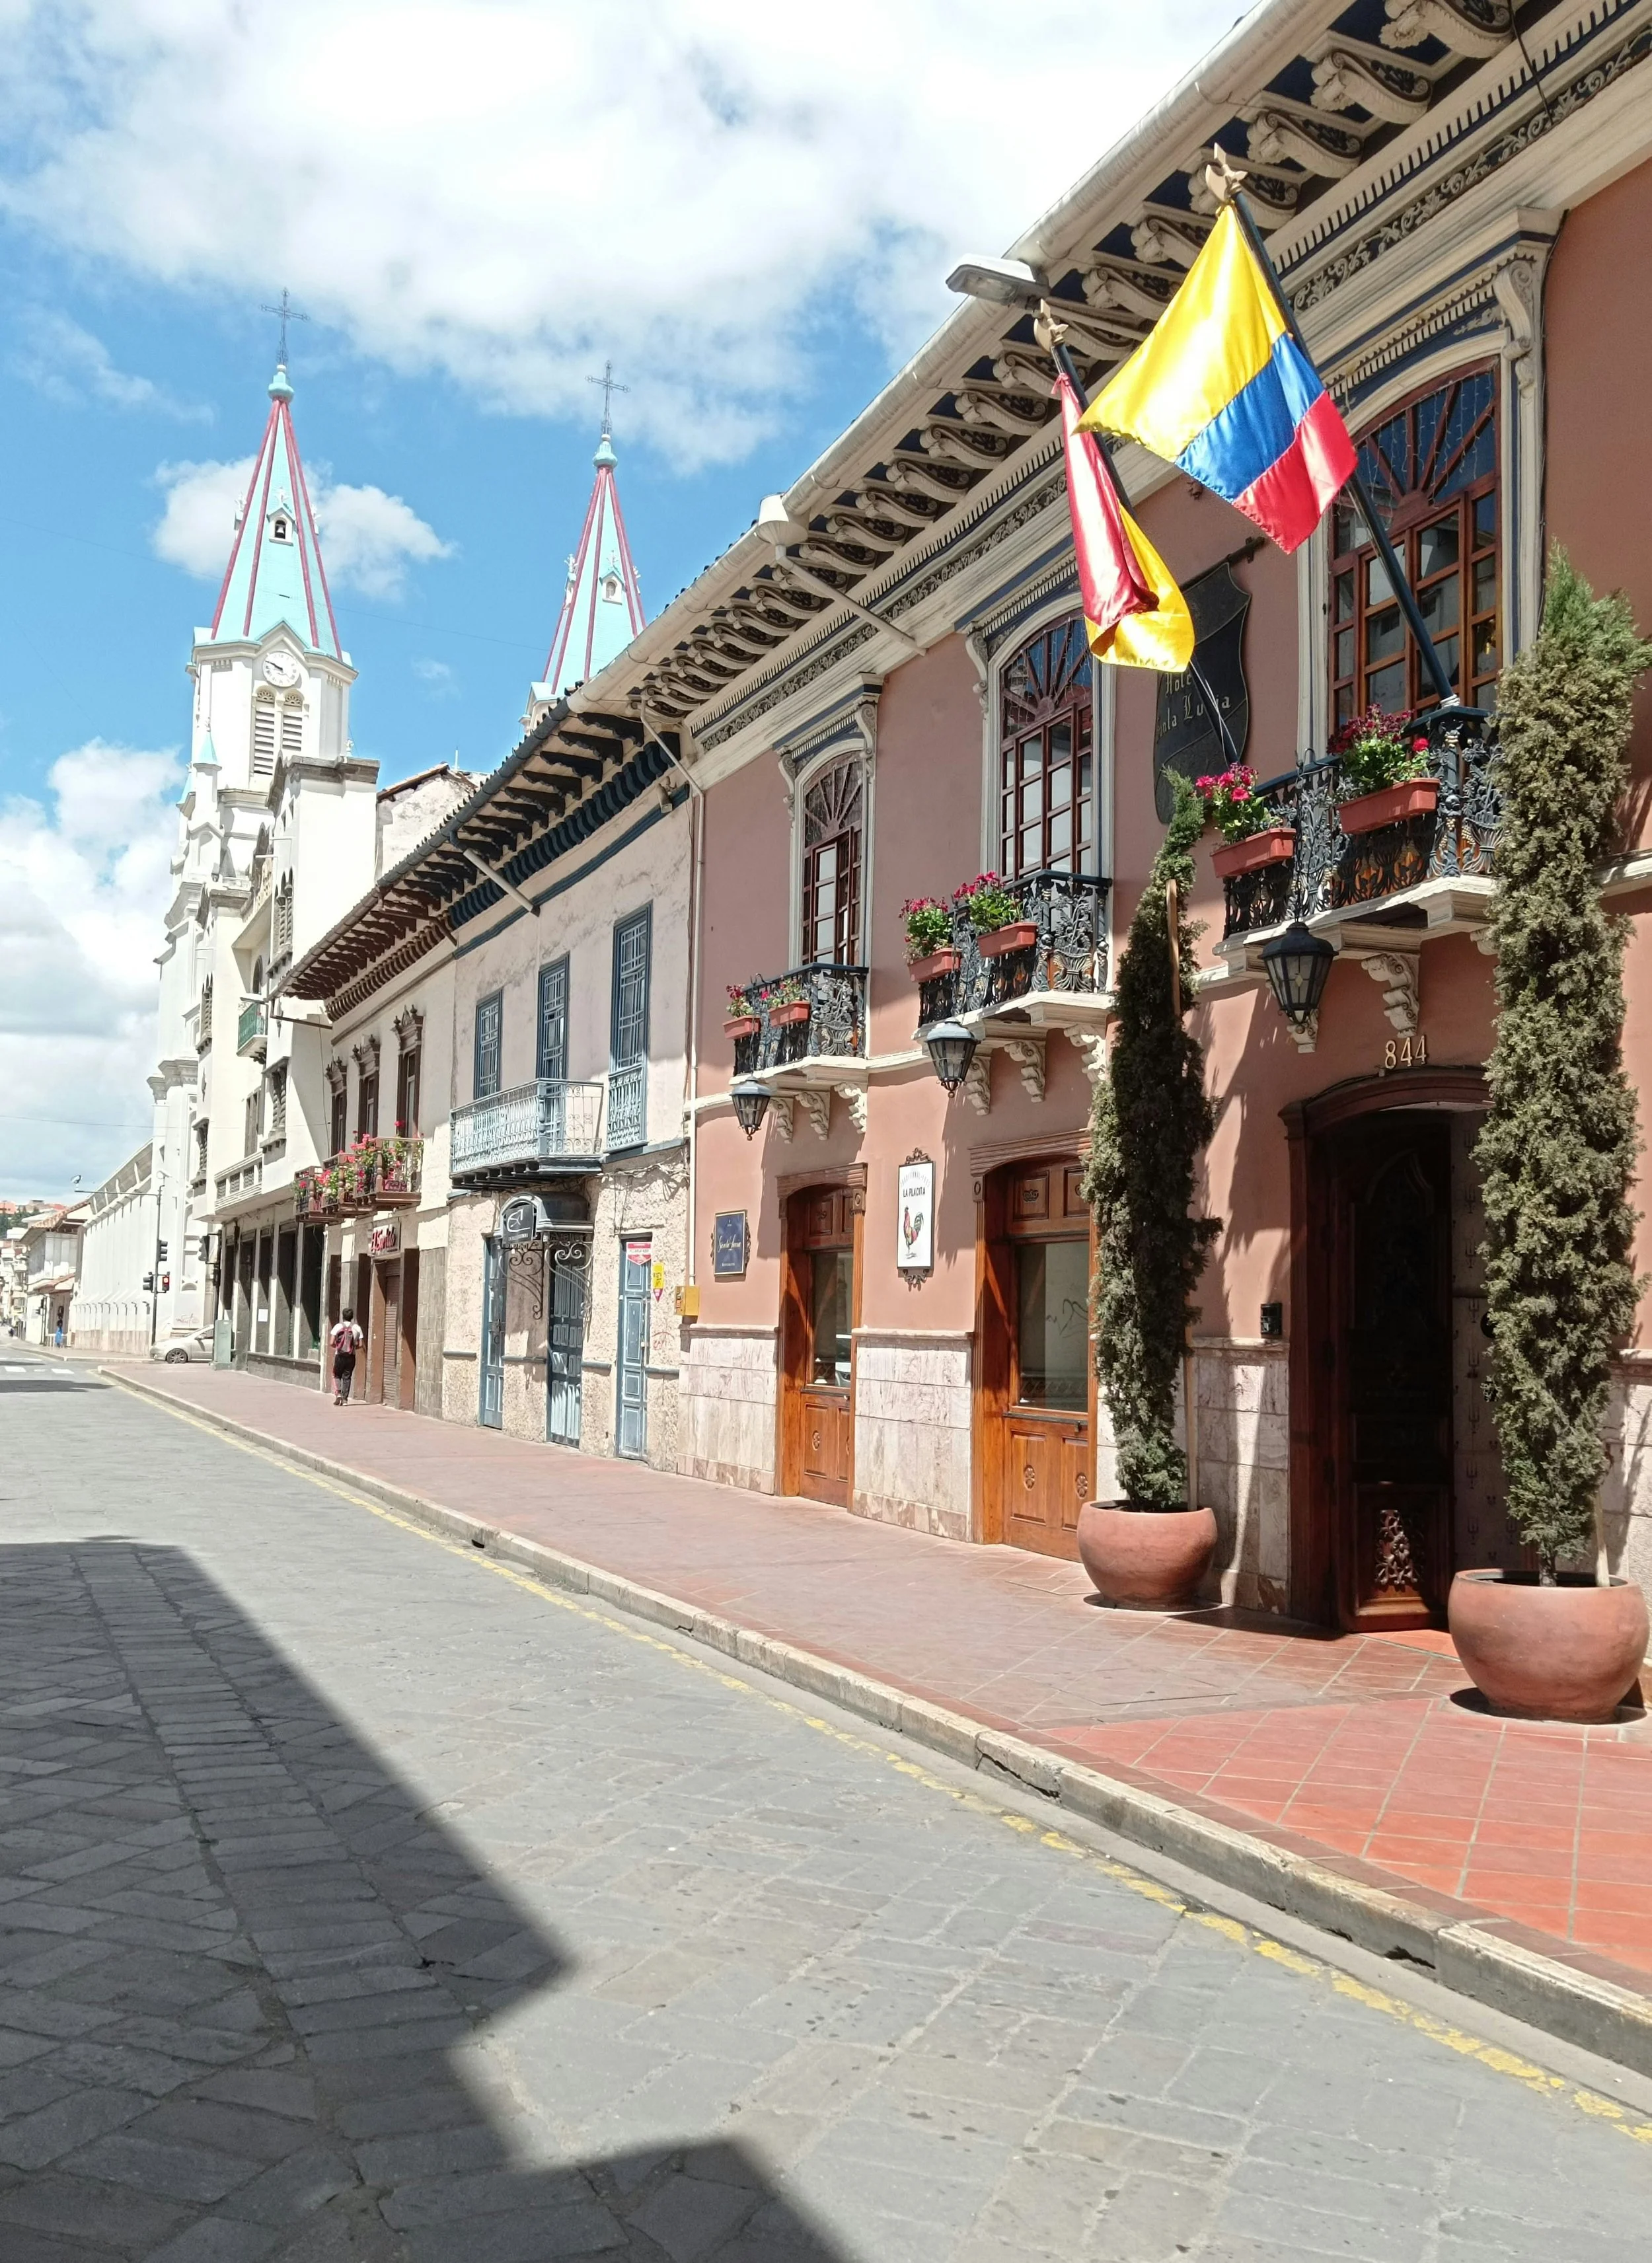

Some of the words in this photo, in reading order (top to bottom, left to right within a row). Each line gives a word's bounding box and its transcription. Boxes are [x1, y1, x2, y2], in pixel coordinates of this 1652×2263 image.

[1165, 672, 1192, 698] Hote
[1183, 692, 1230, 722] Luia
[1385, 1035, 1427, 1069] 844
[903, 1189, 908, 1197] LA
[909, 1187, 925, 1197] PLACITA
